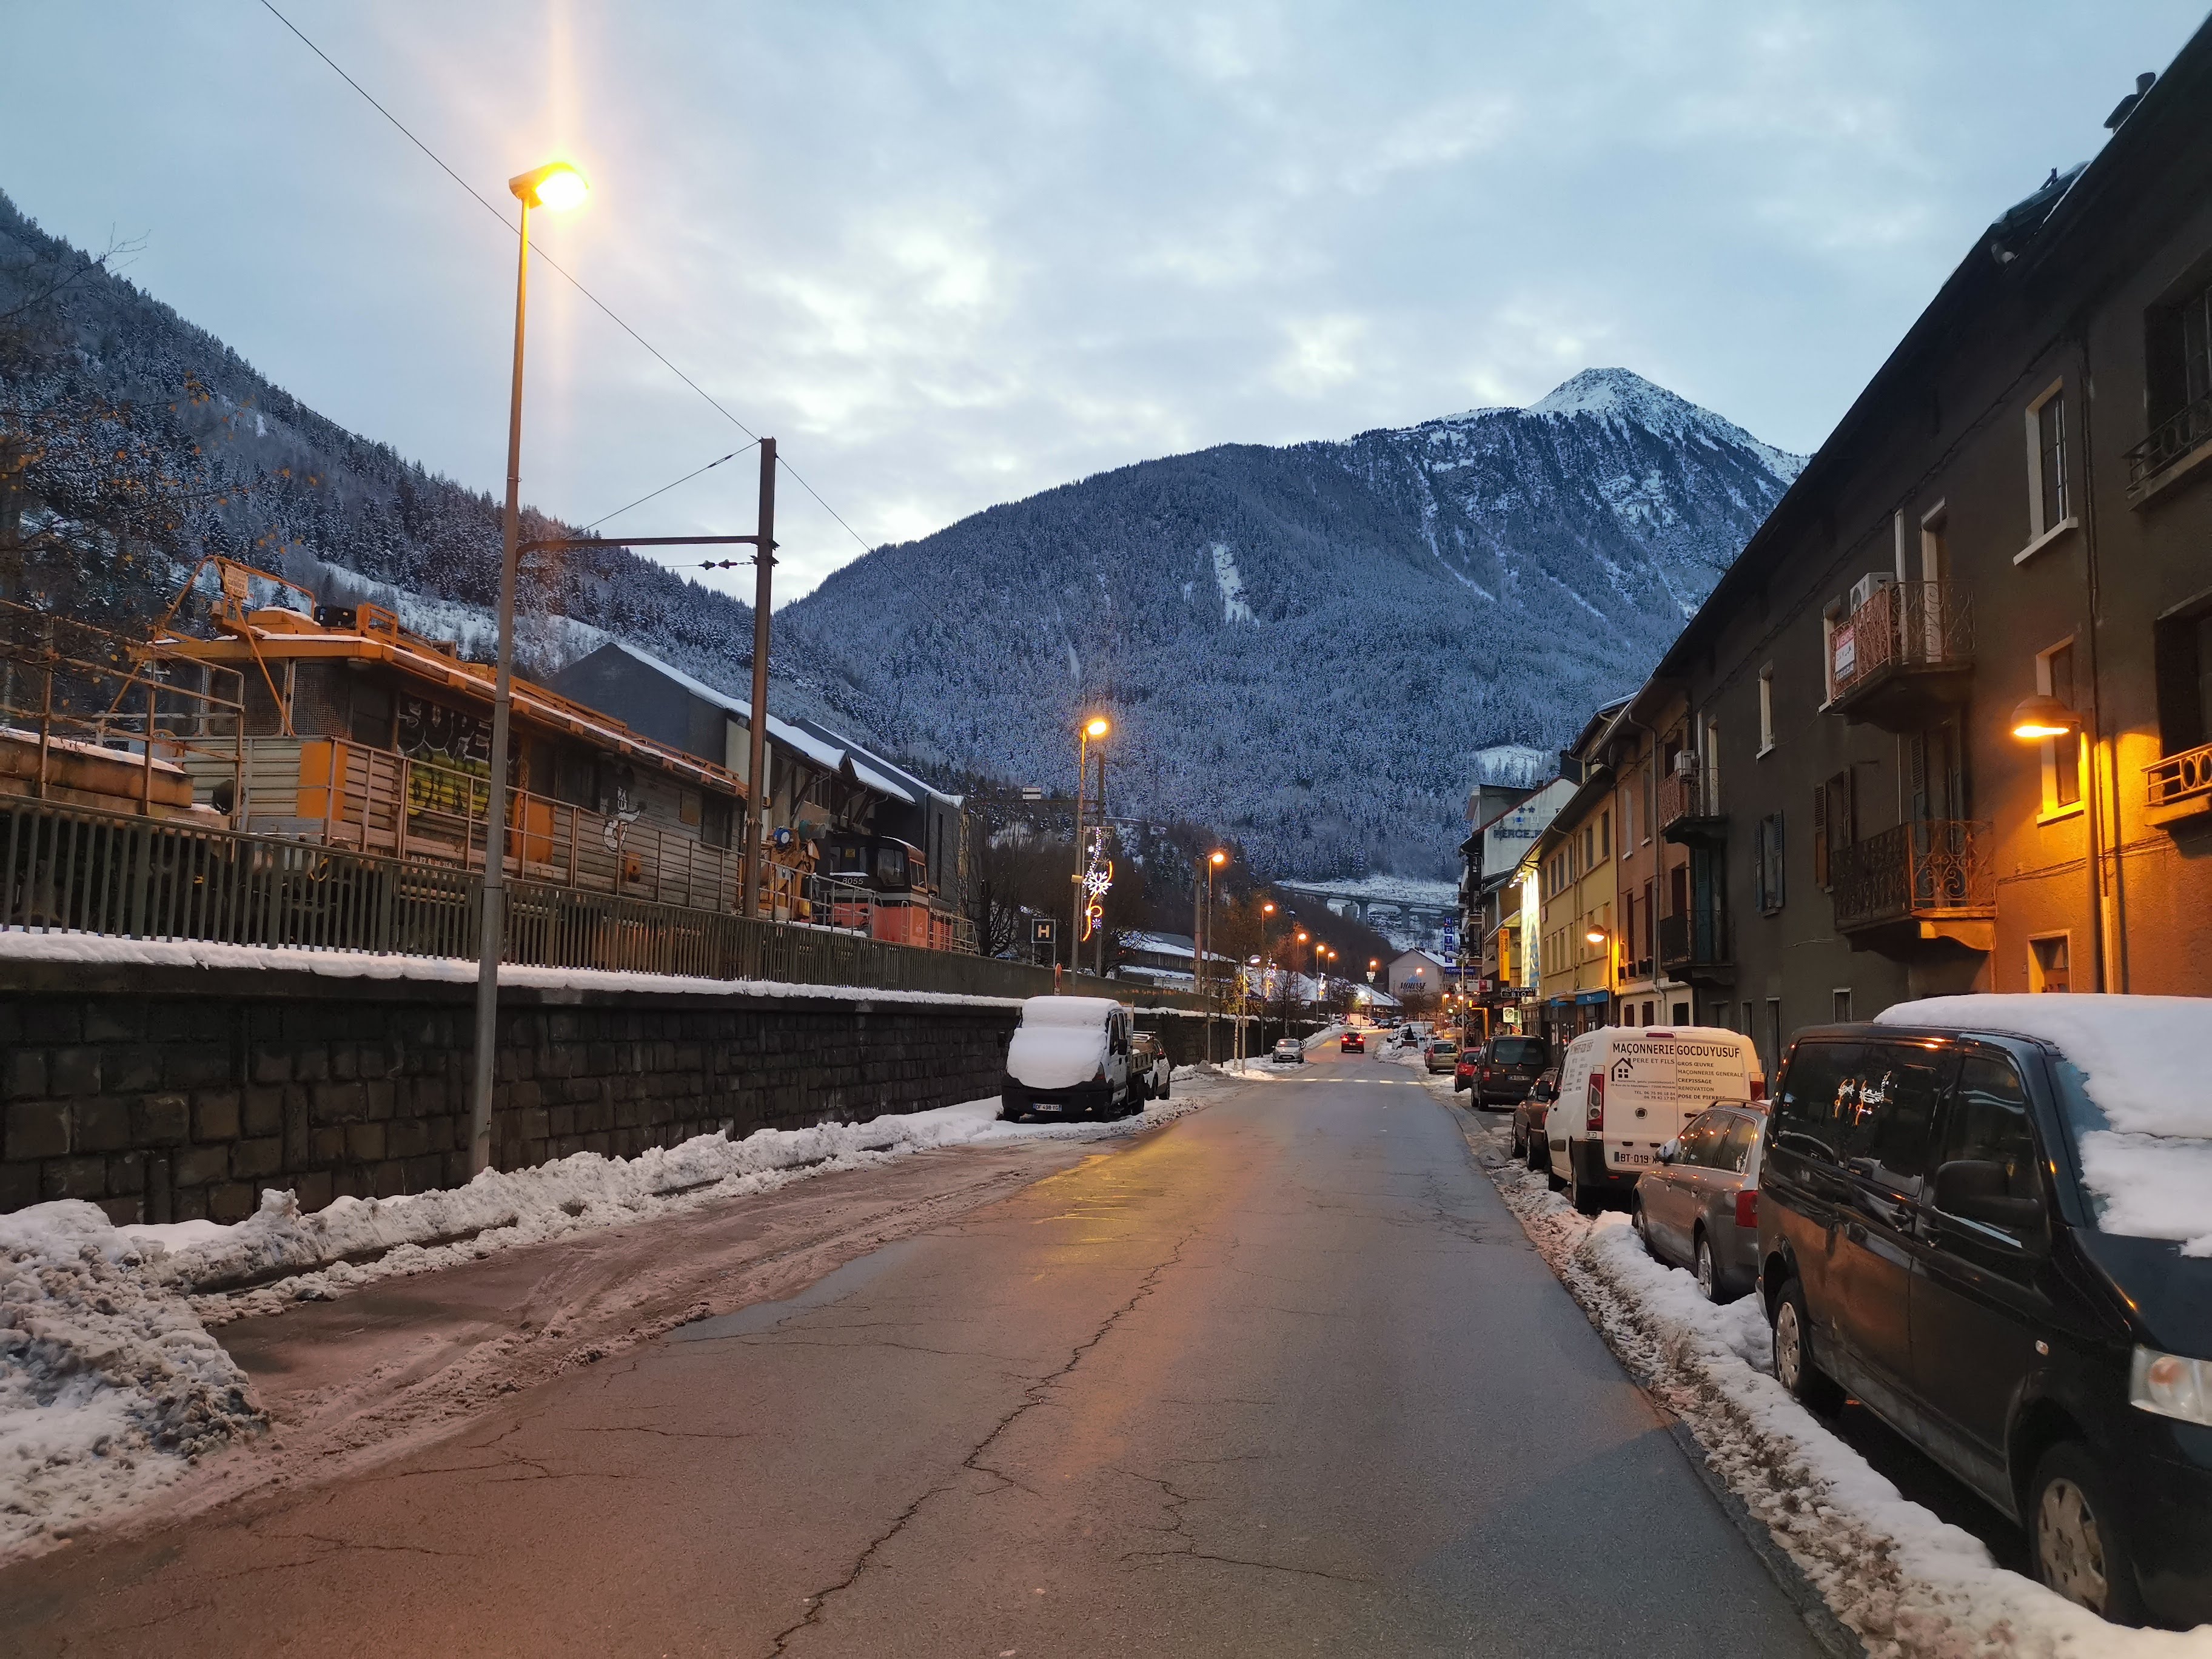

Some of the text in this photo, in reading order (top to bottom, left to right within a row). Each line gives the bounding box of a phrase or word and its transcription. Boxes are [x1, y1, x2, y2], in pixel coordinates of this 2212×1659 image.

[1037, 925, 1050, 938] H
[1613, 1043, 1740, 1058] MAÇONNERIE GOCDUYUSUF
[1621, 1154, 1657, 1164] BT-019-X
